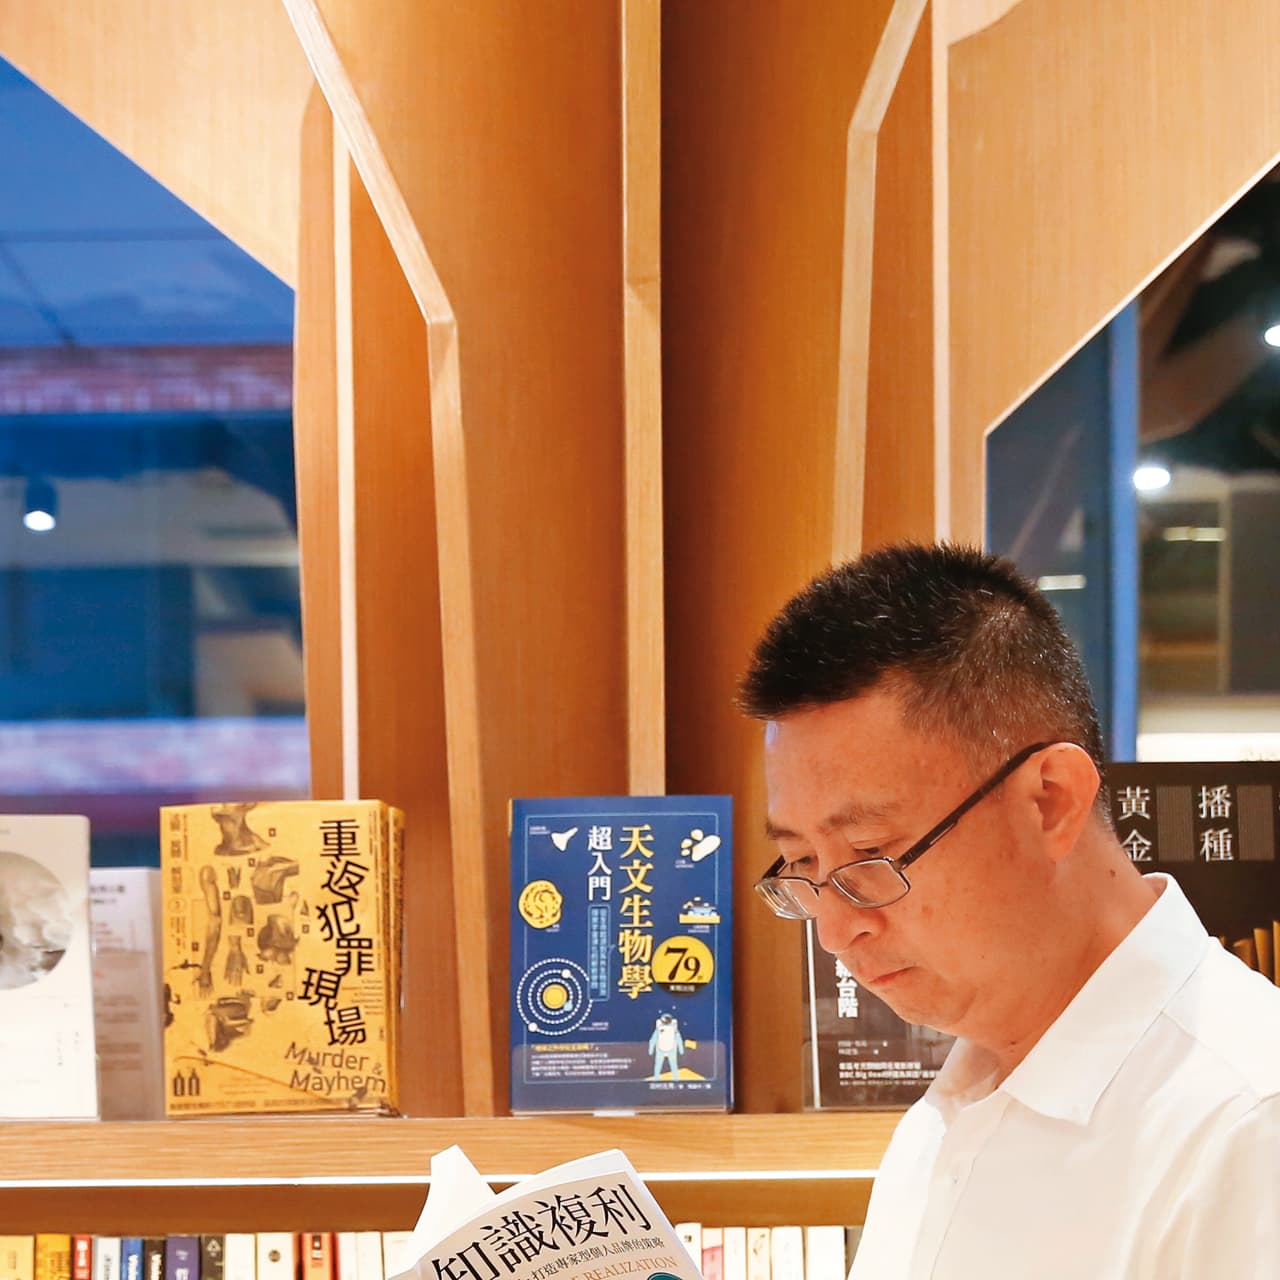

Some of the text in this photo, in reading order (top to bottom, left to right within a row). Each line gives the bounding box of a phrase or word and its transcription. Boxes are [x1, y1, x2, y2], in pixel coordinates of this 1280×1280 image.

[1116, 784, 1152, 862] 黃金
[1198, 784, 1233, 862] 播種
[588, 825, 612, 900] 超入門
[298, 820, 375, 1046] 重返犯罪現場
[618, 824, 654, 1000] 天文生物學
[285, 1042, 368, 1072] Murder
[289, 1070, 386, 1097] Mayhem
